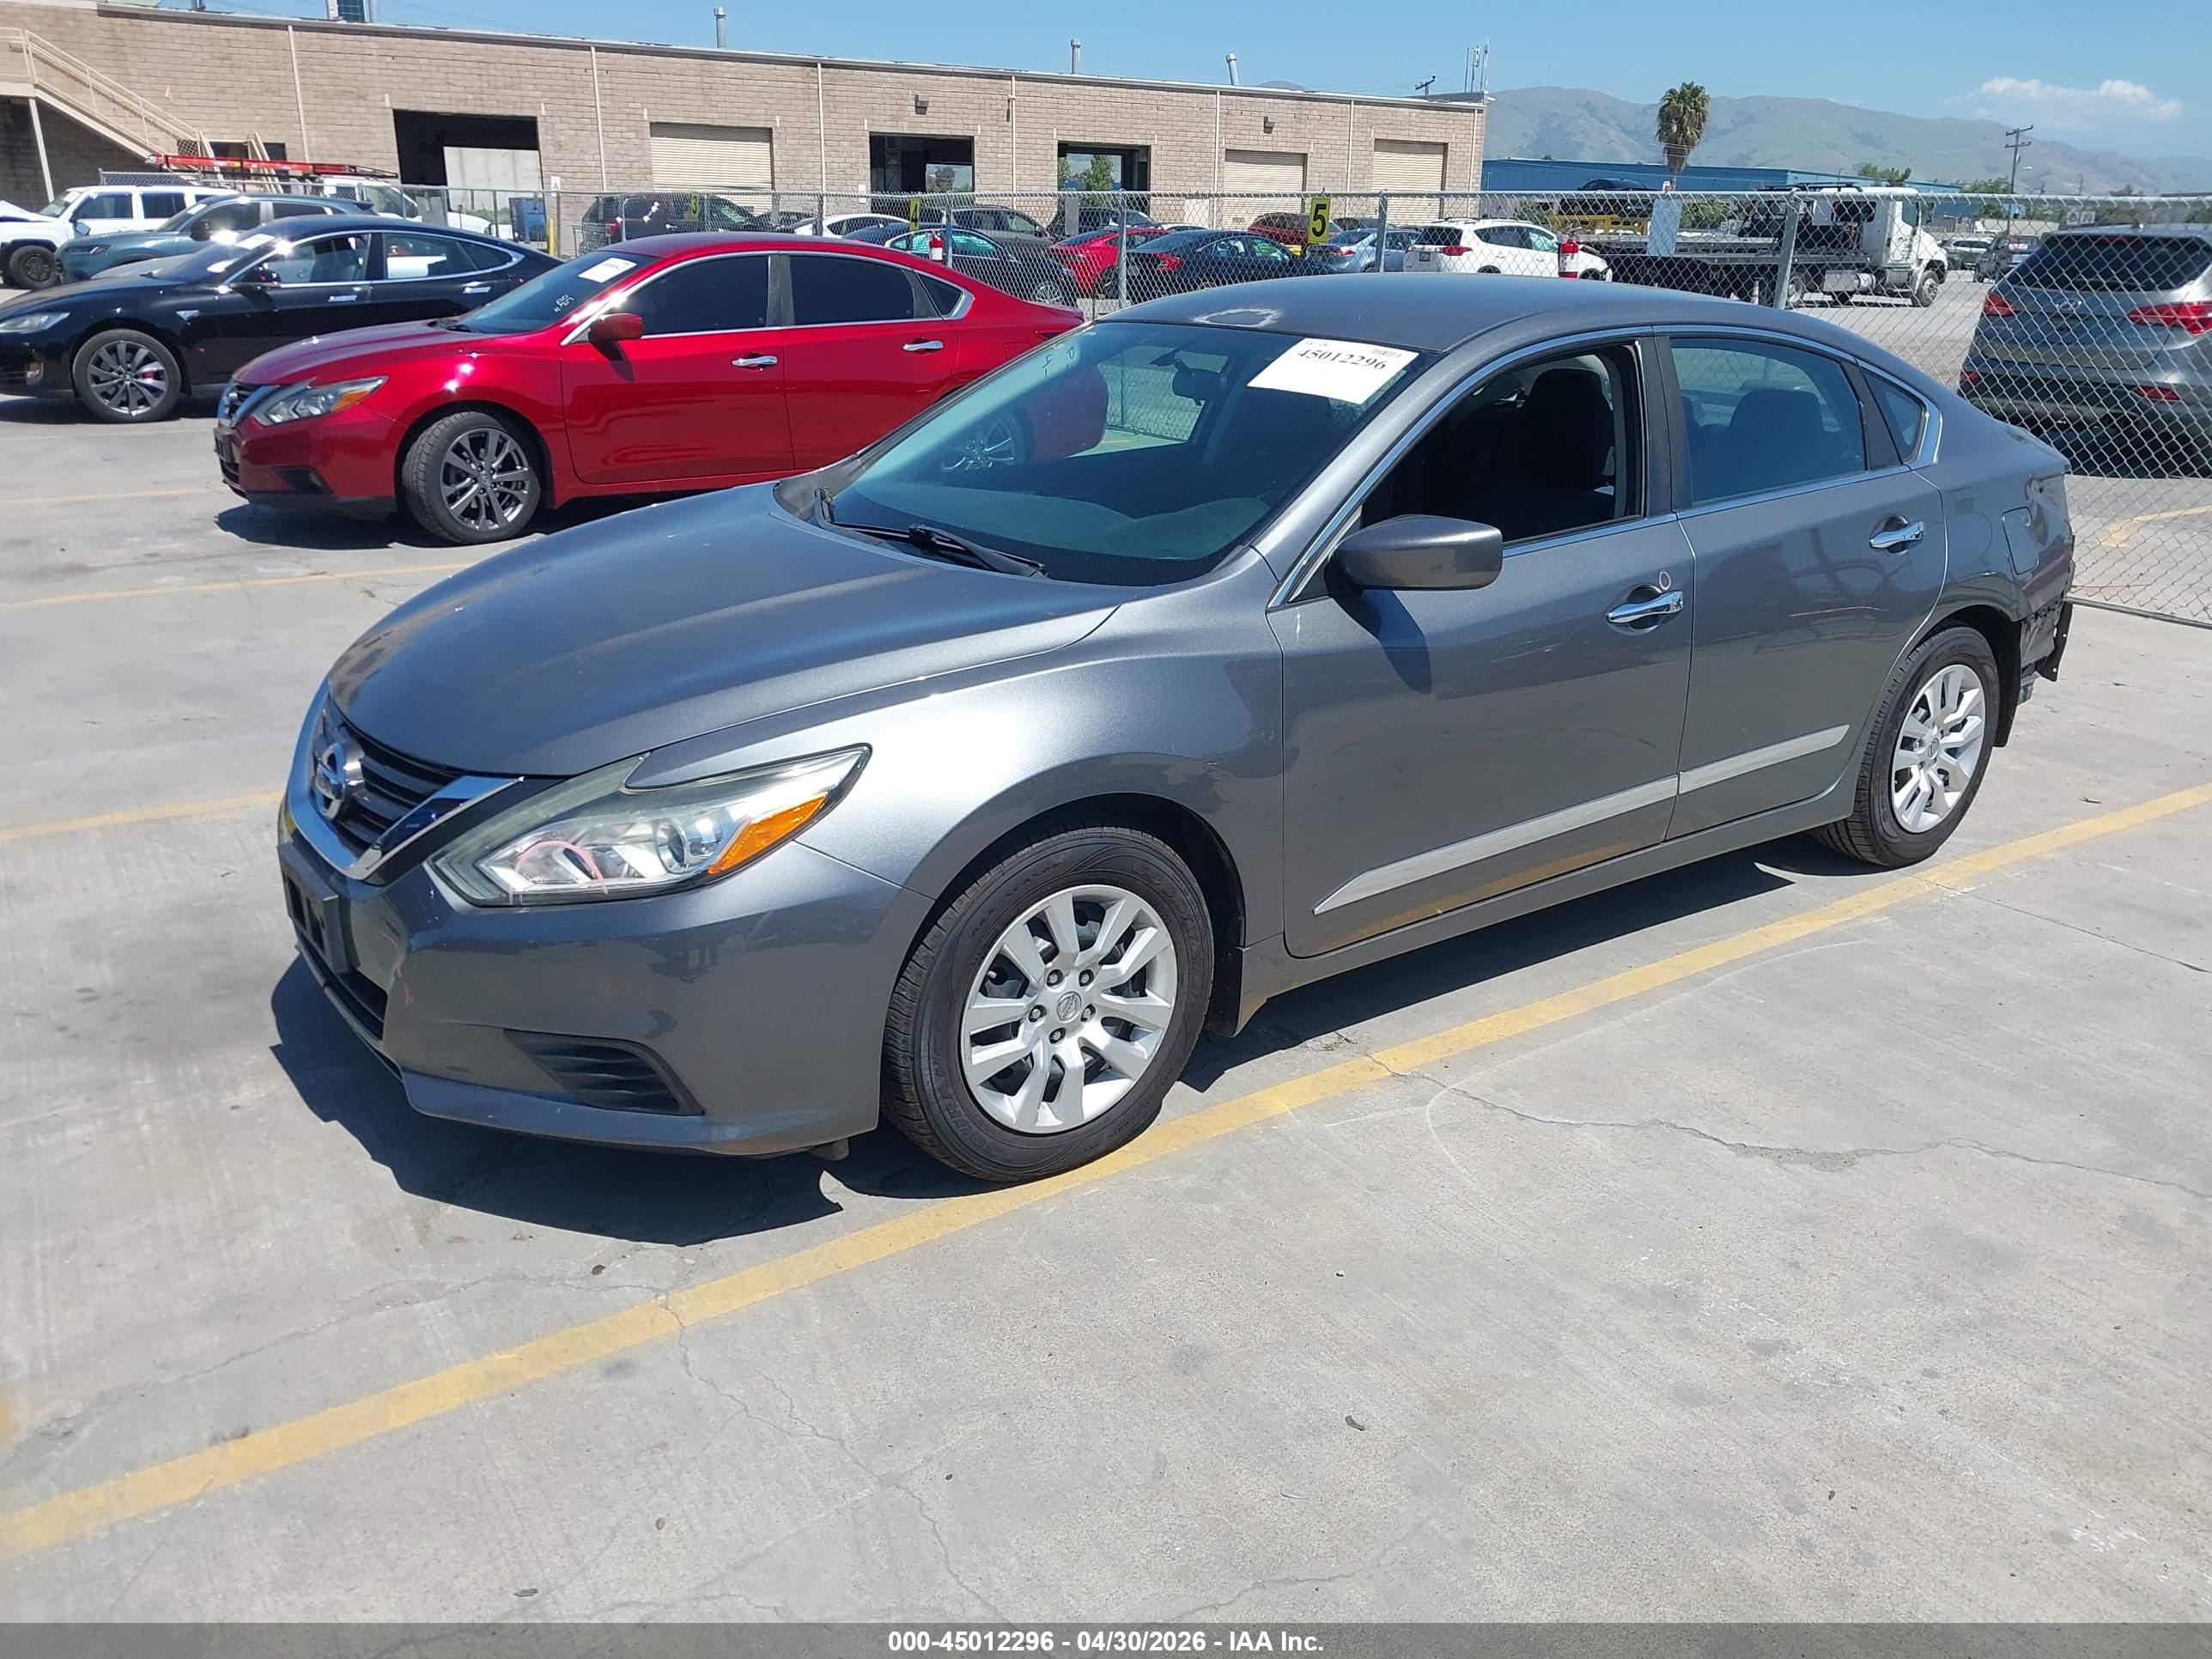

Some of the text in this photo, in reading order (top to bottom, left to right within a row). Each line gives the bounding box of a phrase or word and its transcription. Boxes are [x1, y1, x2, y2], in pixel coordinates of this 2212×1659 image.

[691, 194, 698, 215] 3
[911, 203, 919, 228] 4
[1311, 203, 1328, 237] 5
[1297, 349, 1388, 370] 45012296
